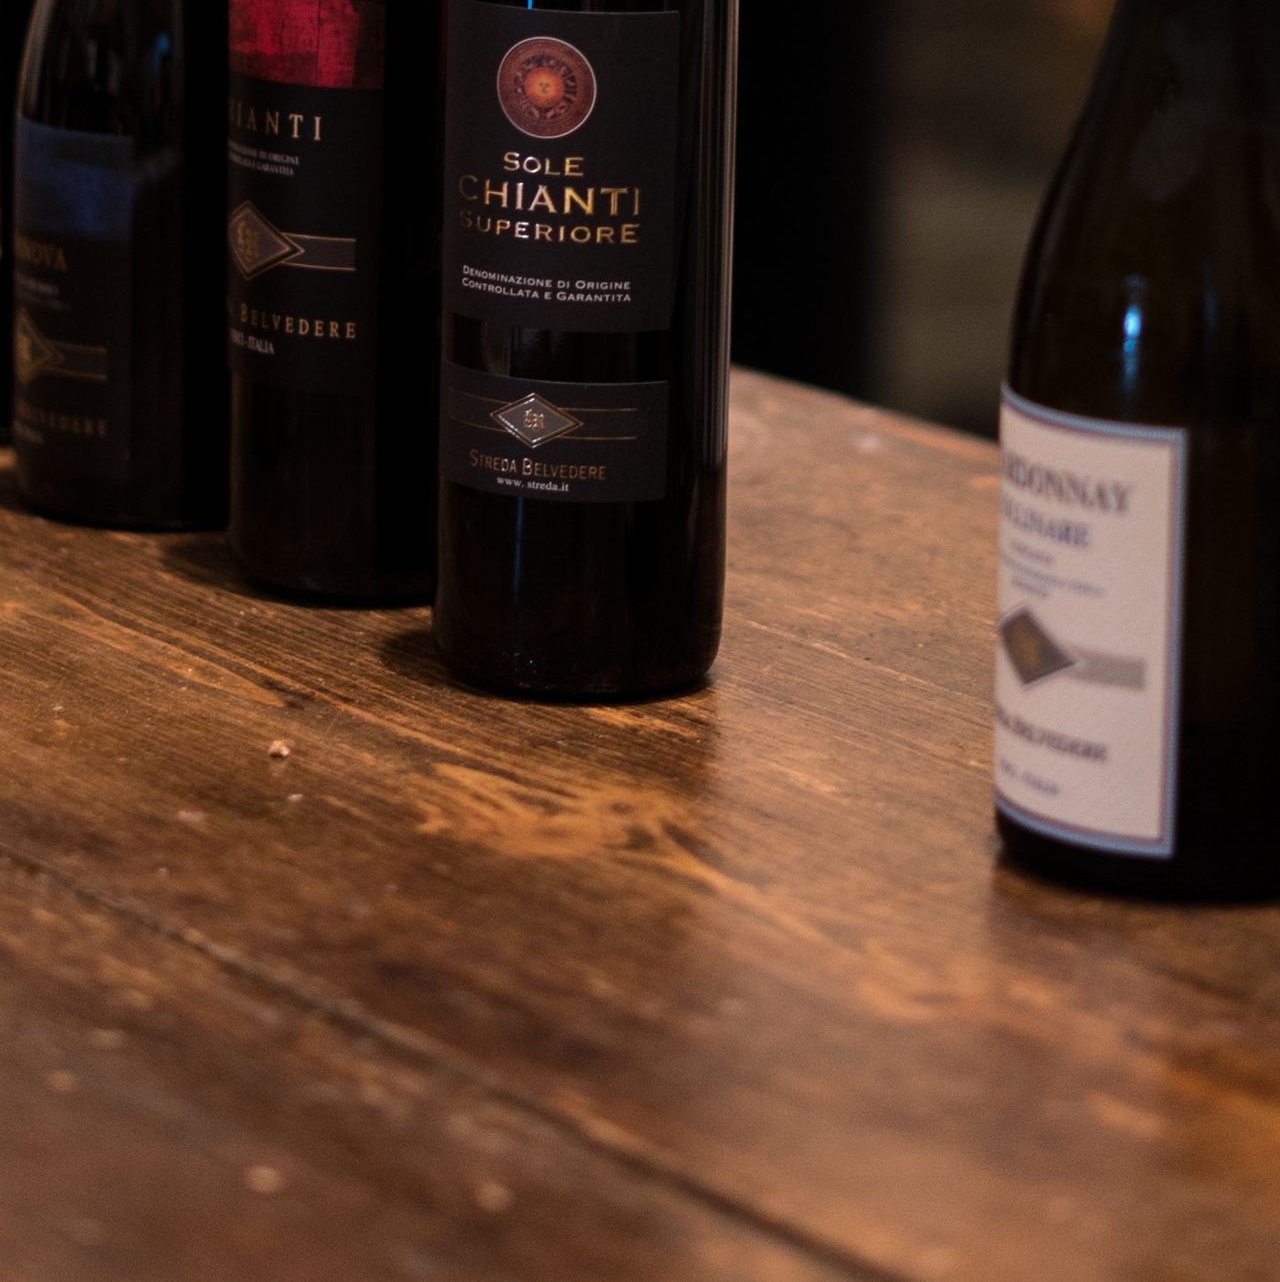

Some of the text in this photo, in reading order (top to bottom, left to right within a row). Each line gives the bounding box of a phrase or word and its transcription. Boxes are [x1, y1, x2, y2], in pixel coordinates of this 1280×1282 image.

[503, 151, 585, 177] SOLE
[459, 174, 641, 216] CHIANTI
[459, 208, 641, 244] SUPERIORE
[461, 277, 632, 302] CONTROLLATA E GARANTITA
[462, 264, 631, 291] DENOMINAZIONE DI ORIGINE
[241, 302, 357, 339] BELVEDERE
[469, 448, 608, 481] STREDA BELVEDERE
